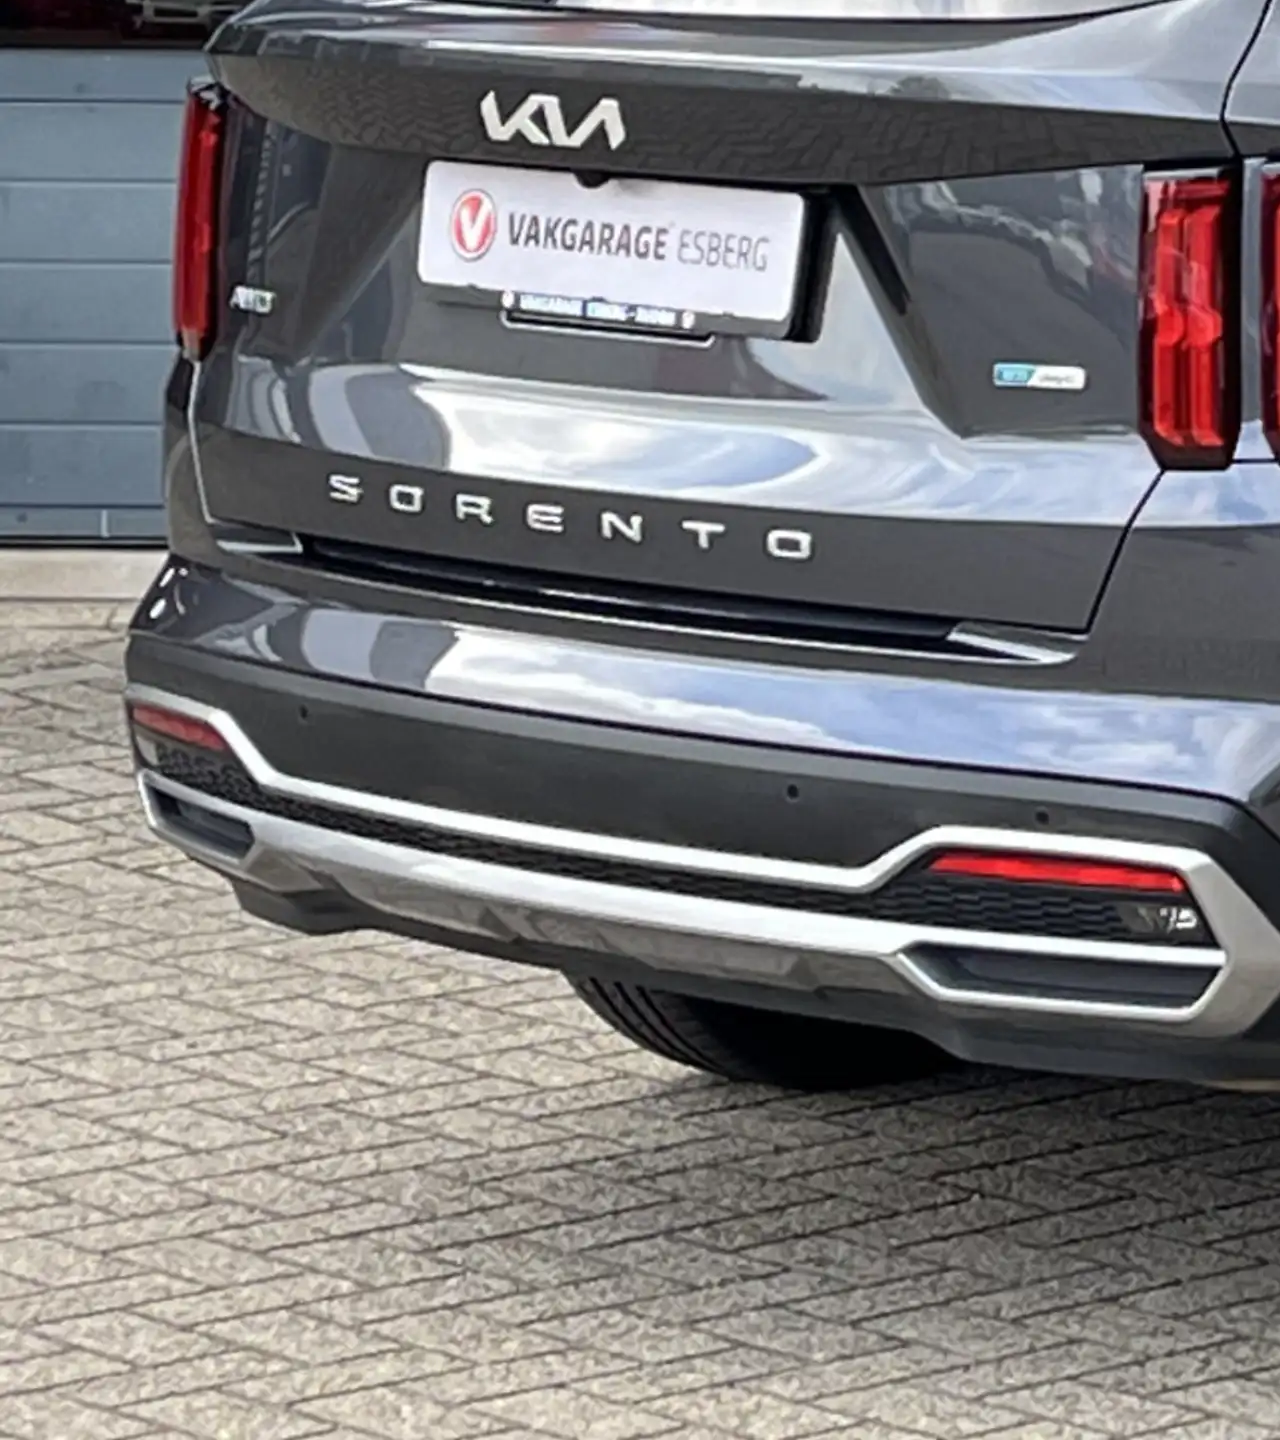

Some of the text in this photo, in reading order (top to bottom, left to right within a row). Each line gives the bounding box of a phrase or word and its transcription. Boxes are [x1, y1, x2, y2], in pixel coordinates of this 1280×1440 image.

[480, 90, 626, 150] KIA
[508, 212, 771, 272] VAKGARAGE ESBERG
[329, 474, 812, 560] SORENTO
